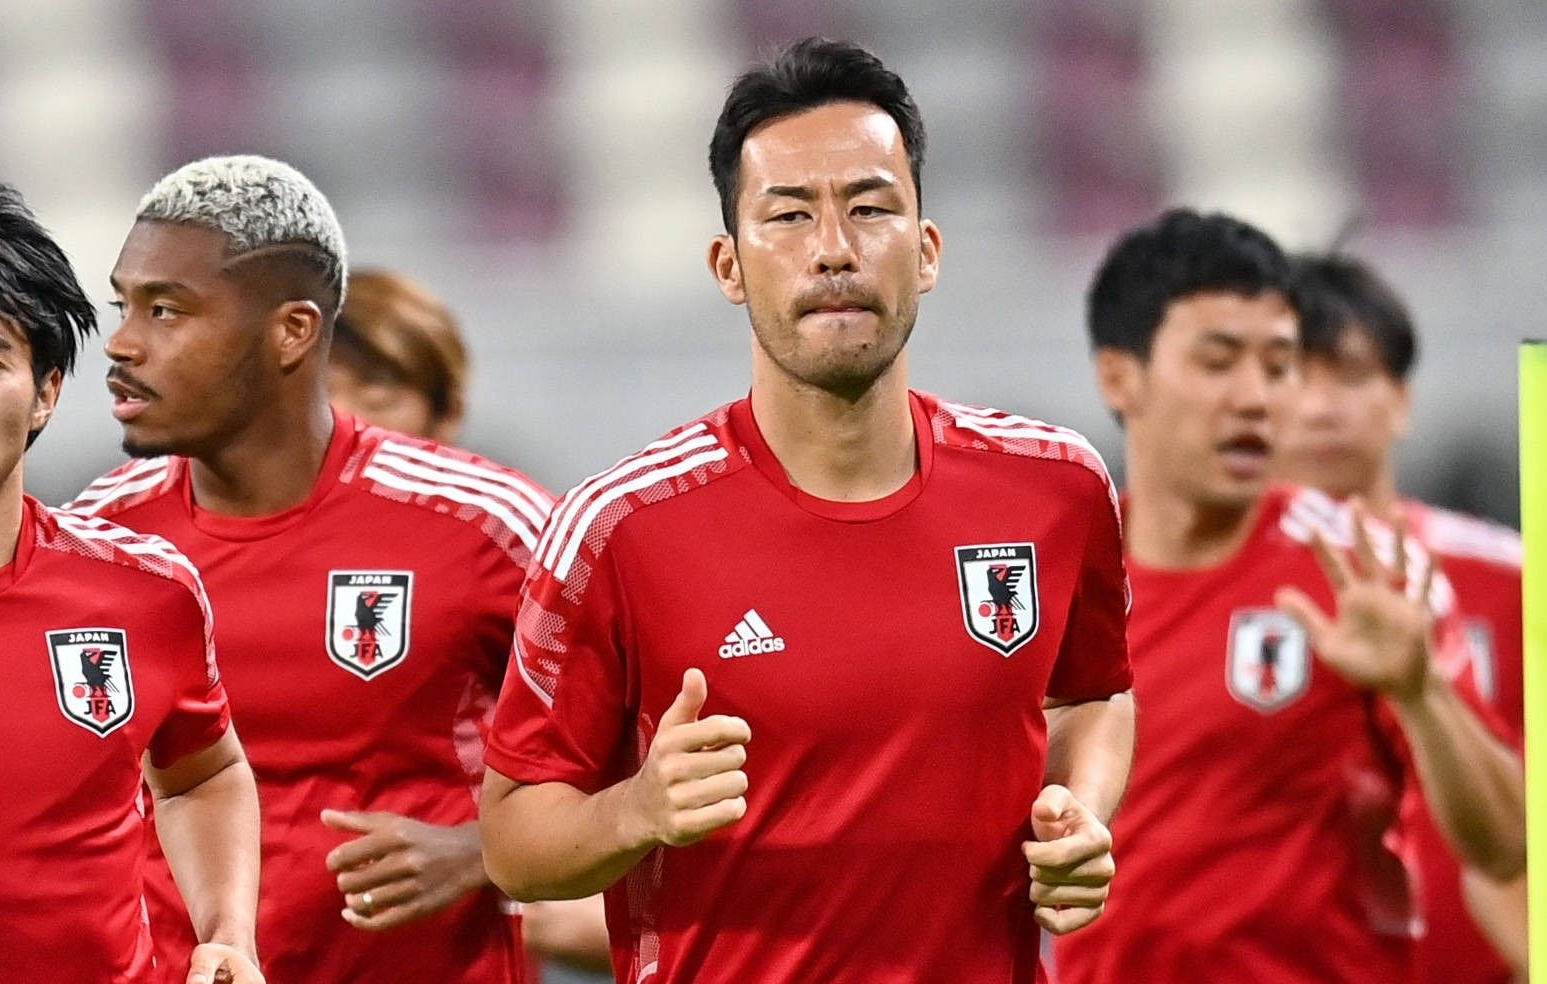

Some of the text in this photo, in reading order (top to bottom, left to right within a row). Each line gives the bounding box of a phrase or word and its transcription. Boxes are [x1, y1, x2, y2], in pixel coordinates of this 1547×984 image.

[976, 548, 1016, 559] JAPAN
[349, 574, 392, 585] JAPAN
[989, 618, 1021, 635] JFA
[68, 632, 110, 643] JAPAN
[350, 643, 384, 659] JFA
[719, 637, 785, 659] adidas
[84, 699, 116, 717] JFA
